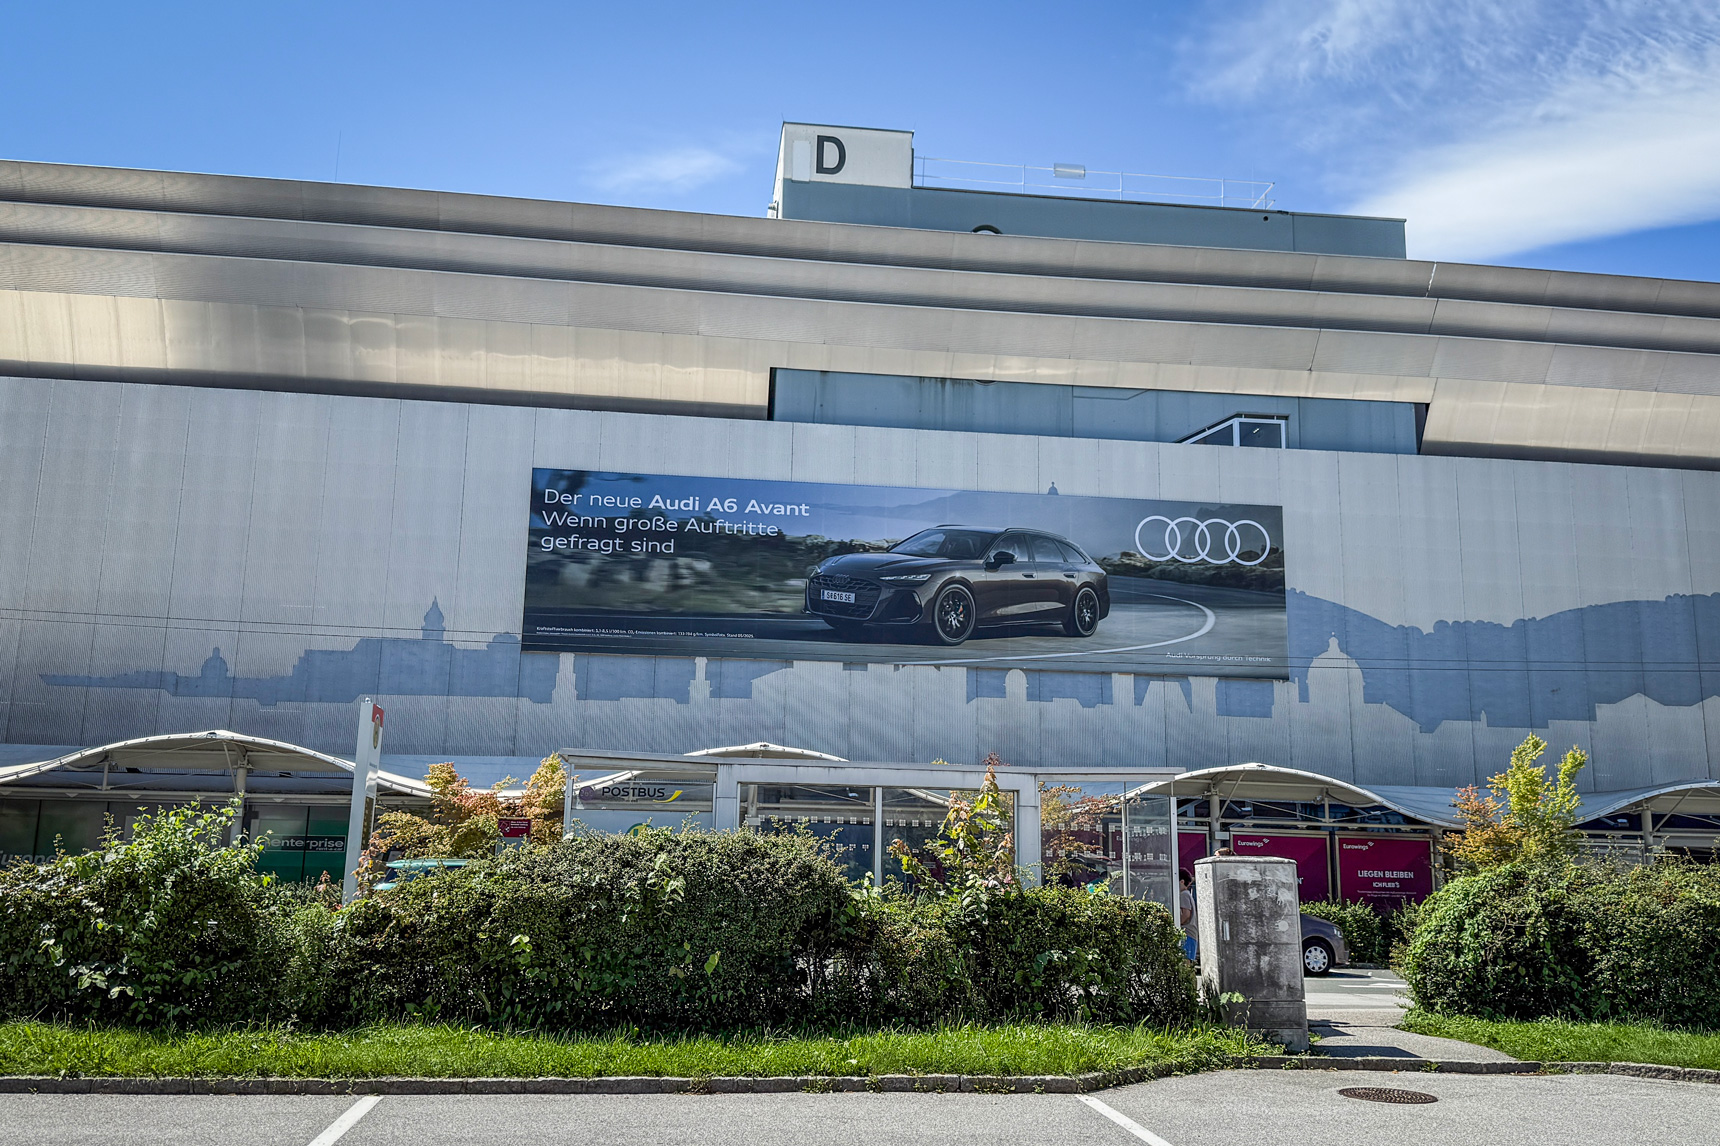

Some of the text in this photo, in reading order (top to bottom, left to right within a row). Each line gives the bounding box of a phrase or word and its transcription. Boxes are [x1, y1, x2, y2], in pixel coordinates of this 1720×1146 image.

[816, 134, 846, 175] D
[544, 488, 810, 516] Der neue Audi A6 Avant
[542, 510, 778, 536] Wenn große Auftritte
[541, 534, 674, 554] gefragt sind
[602, 787, 665, 797] POSTBUS
[271, 838, 344, 850] enterprise
[1237, 840, 1264, 848] Eurowings
[1357, 869, 1414, 879] LIEGEN BLEIBEN
